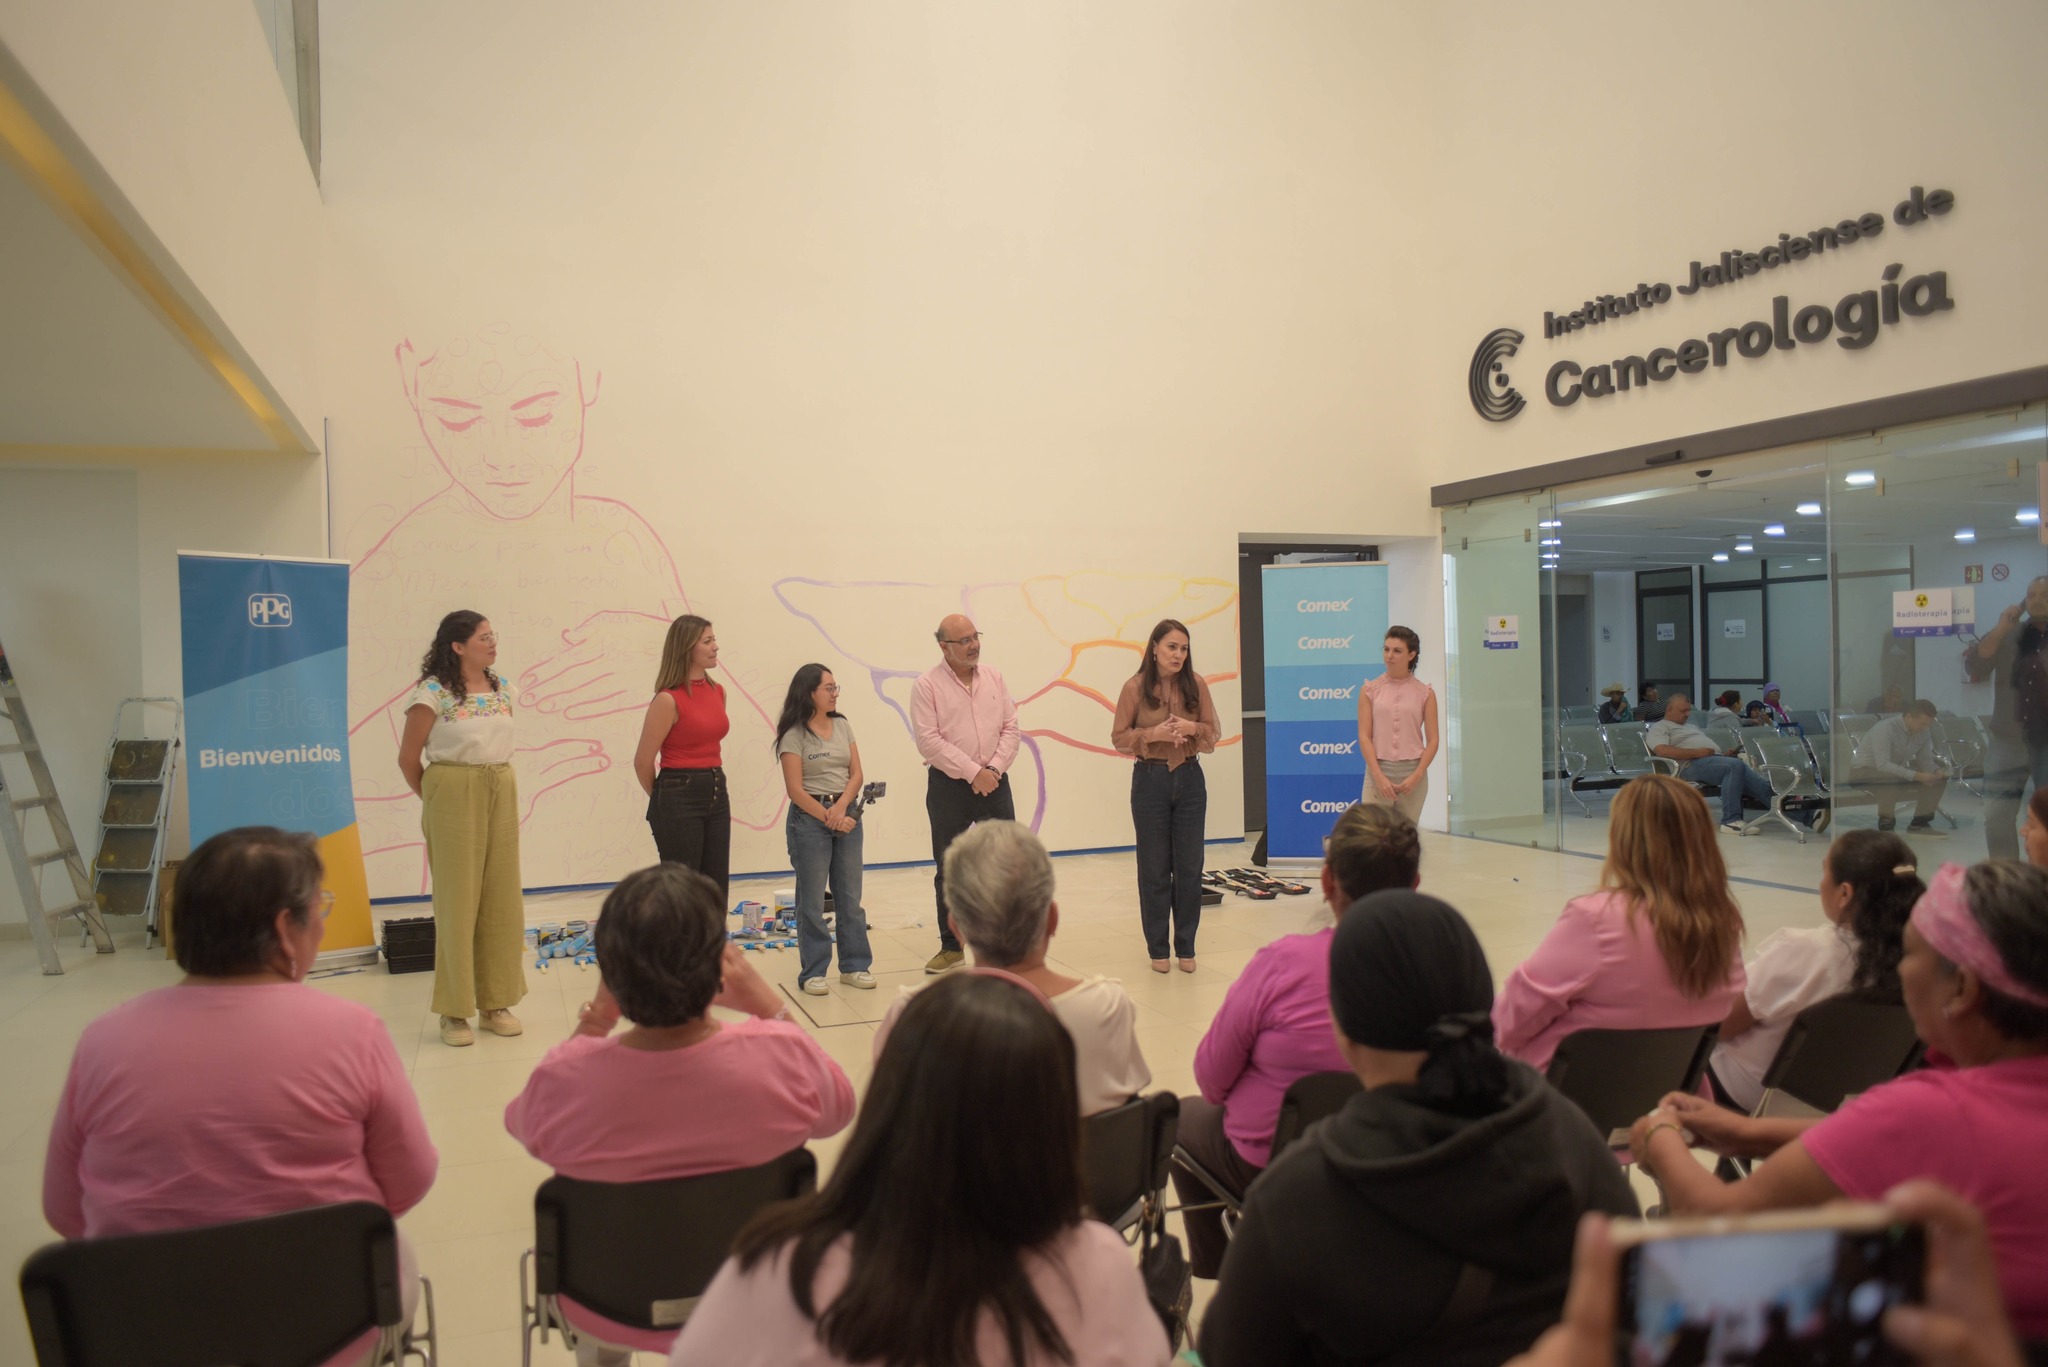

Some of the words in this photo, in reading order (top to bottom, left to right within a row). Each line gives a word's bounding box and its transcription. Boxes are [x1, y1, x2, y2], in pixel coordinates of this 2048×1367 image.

[1543, 281, 1671, 339] Instituto
[1677, 211, 1884, 296] Jalisciense
[1893, 185, 1955, 226] de
[1545, 262, 1955, 408] Cancerología
[251, 597, 290, 624] PPG
[1296, 597, 1354, 613] Comex
[1896, 610, 1948, 618] Radioterapia
[1298, 634, 1355, 650] Comex
[1299, 685, 1356, 700] Comex
[1299, 739, 1357, 755] Comex
[200, 743, 342, 769] Bienvenidos
[1300, 798, 1359, 814] Comex
